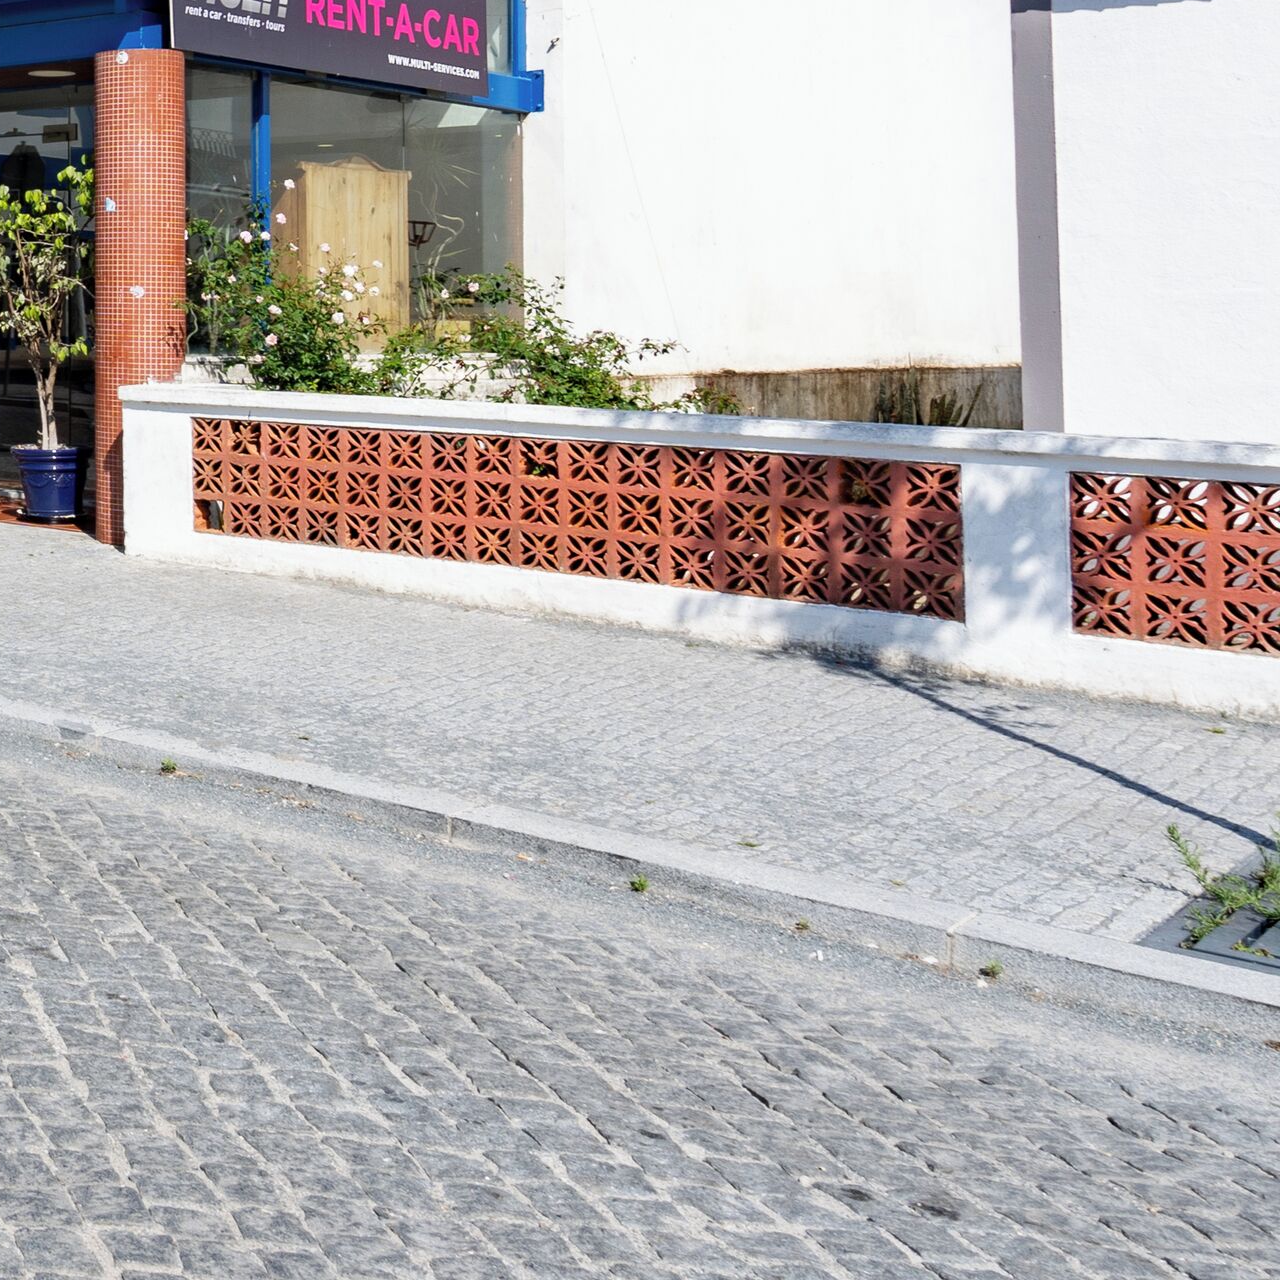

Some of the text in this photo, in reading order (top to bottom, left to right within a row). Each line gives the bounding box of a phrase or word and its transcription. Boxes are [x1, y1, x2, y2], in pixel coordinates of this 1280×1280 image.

[184, 5, 286, 33] rent a car transfers tours
[387, 53, 481, 80] WWW.MULTI-SERVICES.COM
